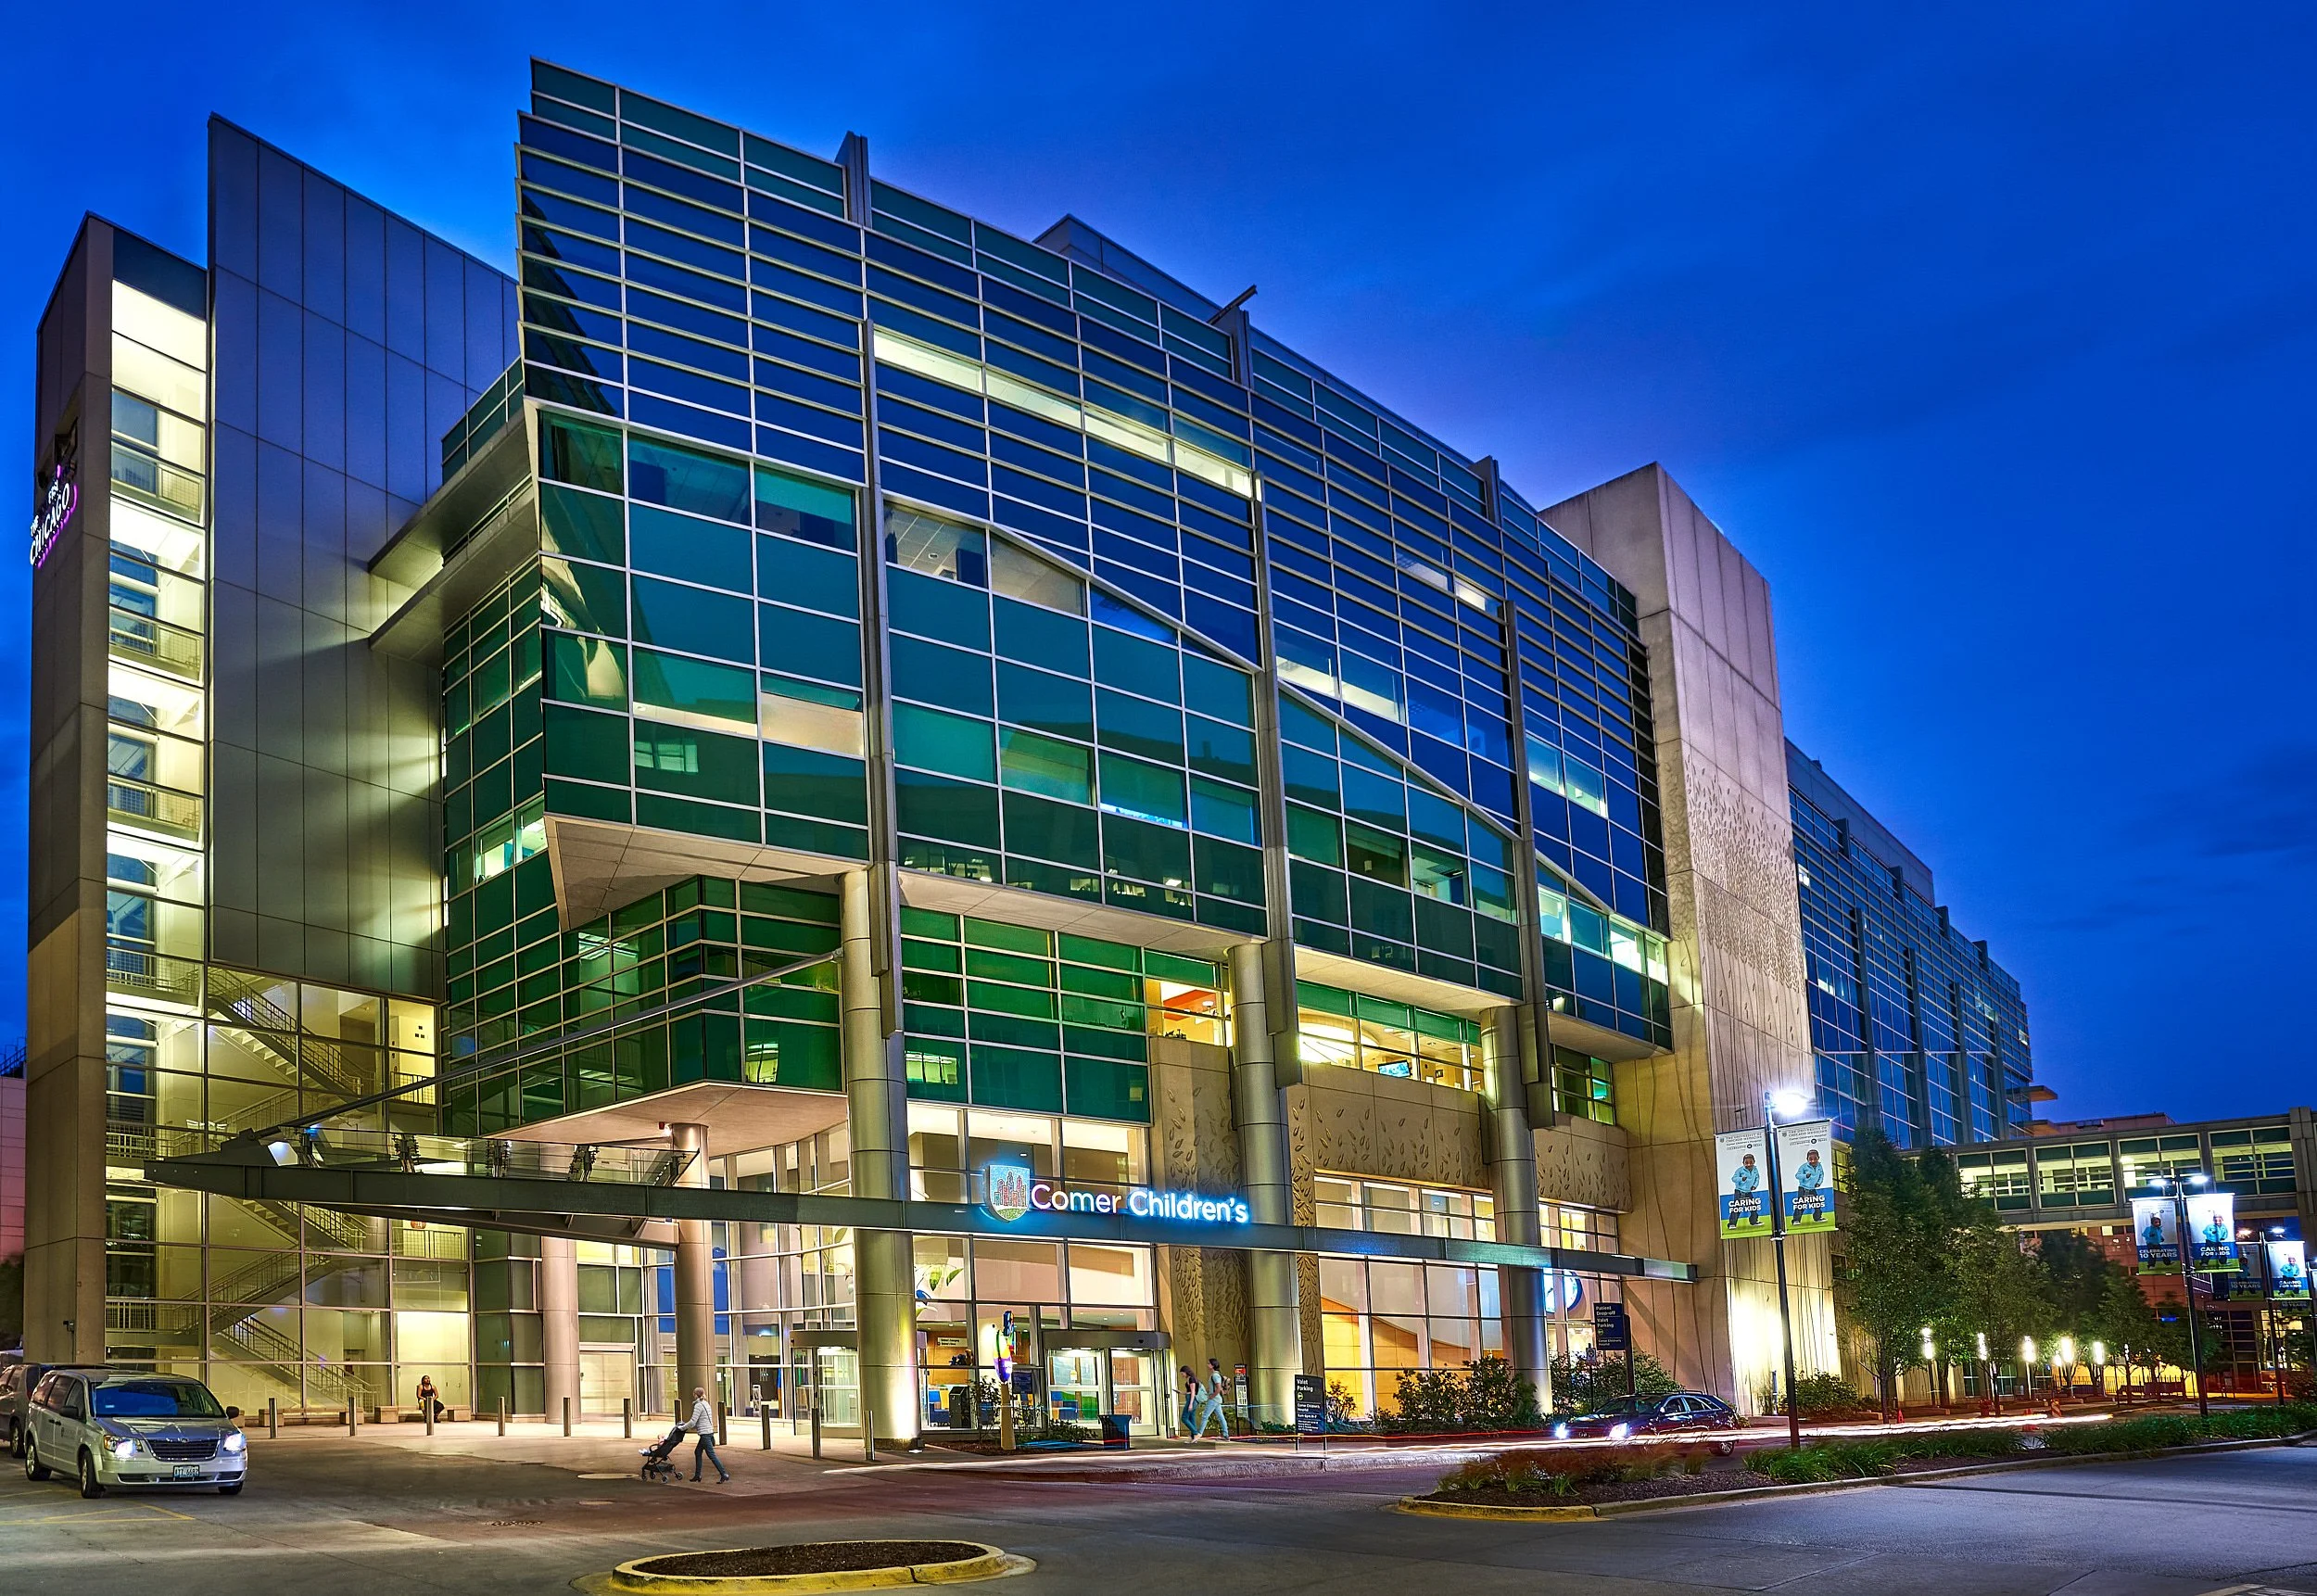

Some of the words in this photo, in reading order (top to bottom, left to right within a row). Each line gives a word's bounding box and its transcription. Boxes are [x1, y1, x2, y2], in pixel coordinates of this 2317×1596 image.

[30, 483, 70, 565] CHICAGO
[1031, 1184, 1121, 1213] Comer
[1129, 1191, 1249, 1223] Children's
[1728, 1197, 1761, 1207] CARING
[1792, 1195, 1825, 1205] CARING
